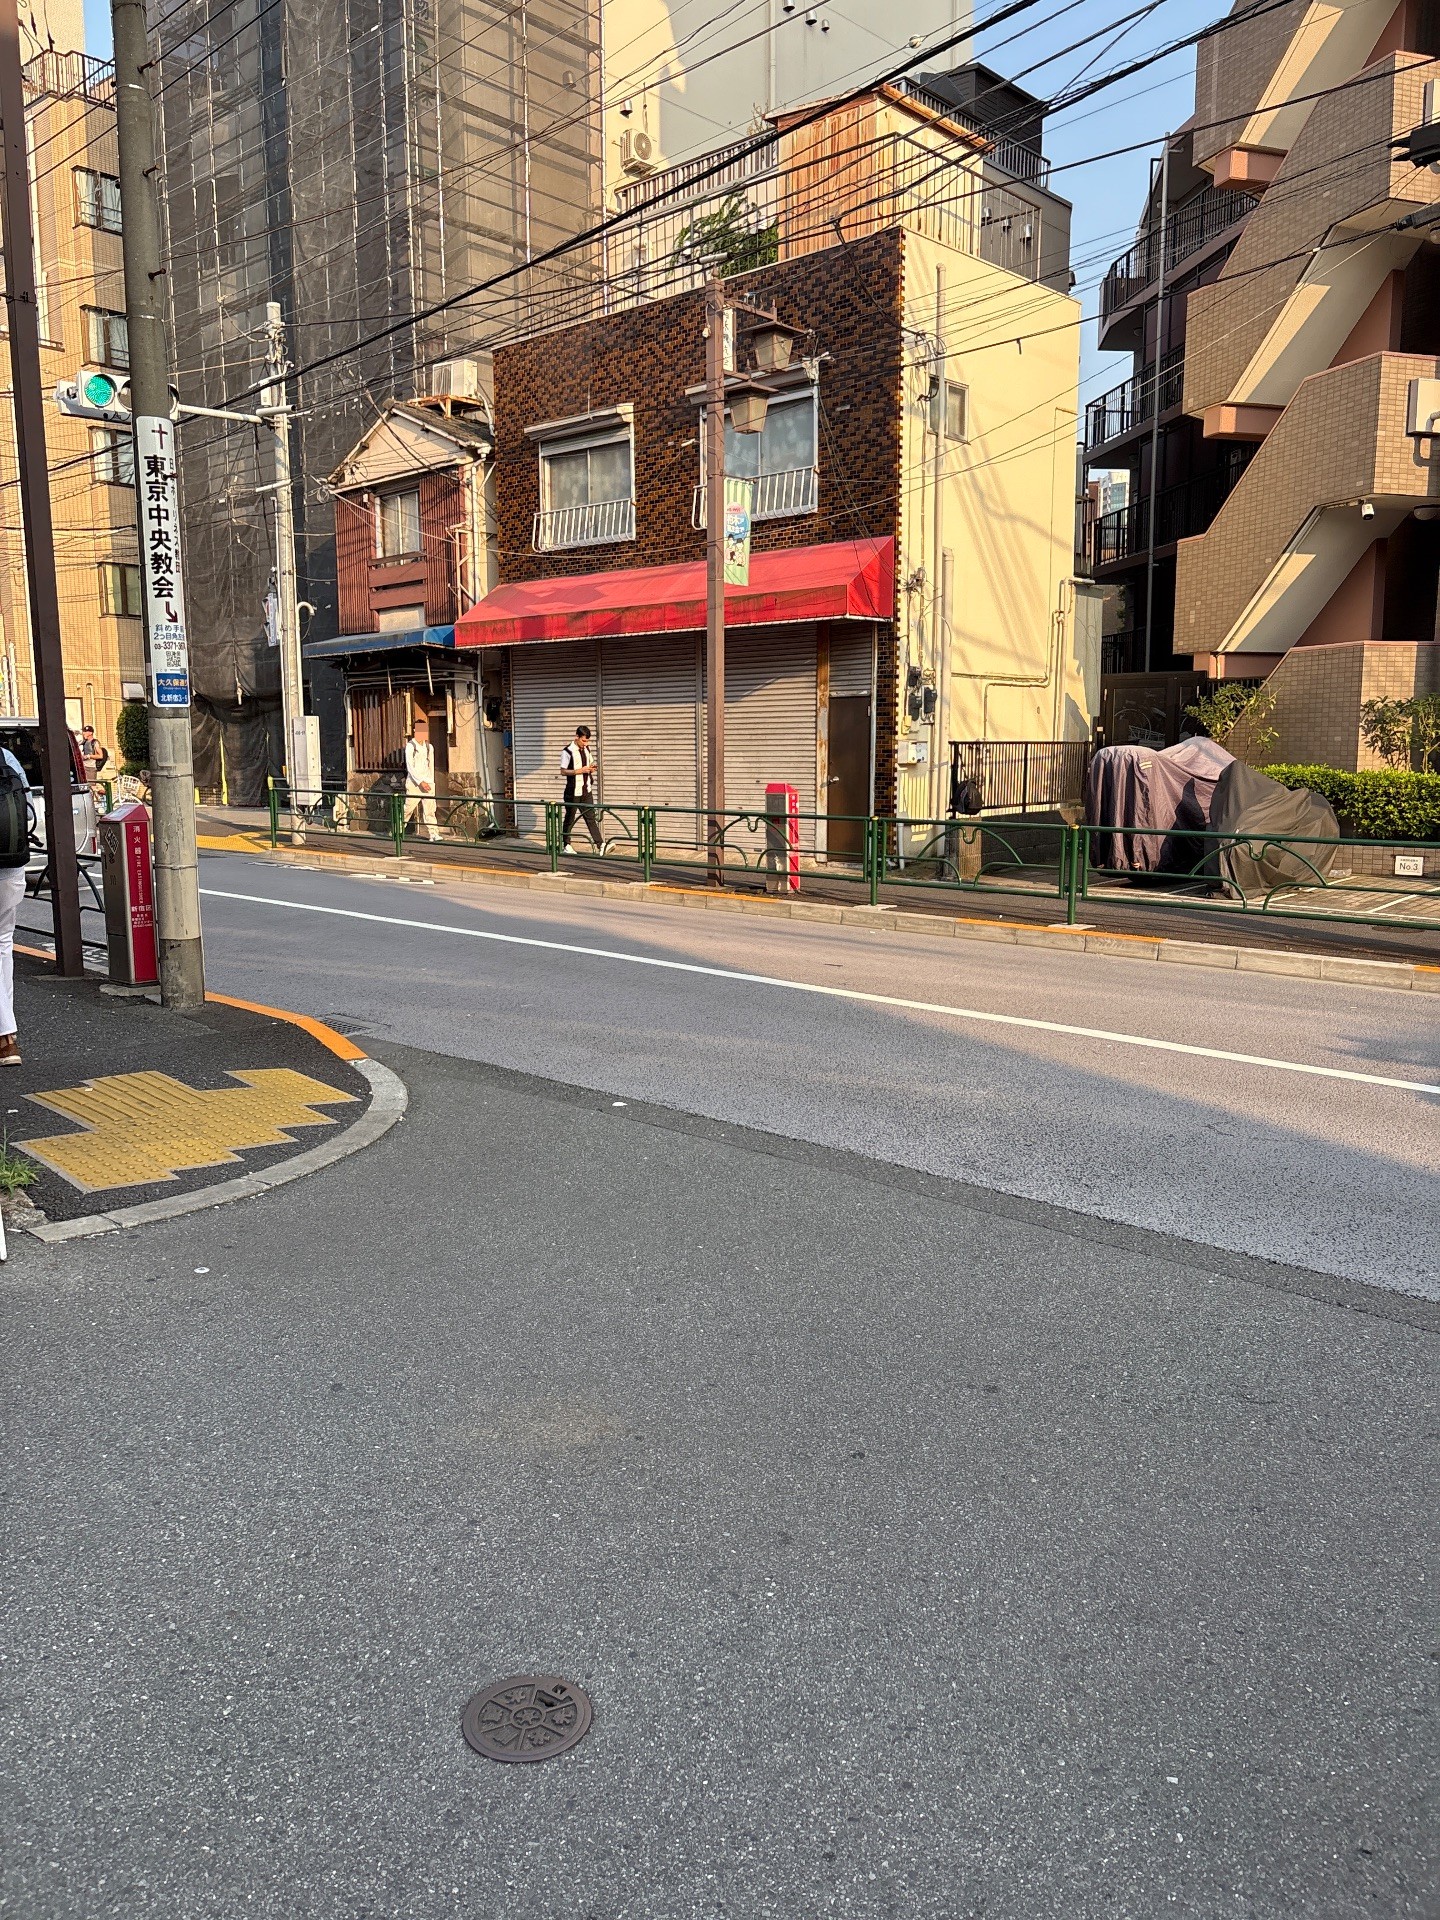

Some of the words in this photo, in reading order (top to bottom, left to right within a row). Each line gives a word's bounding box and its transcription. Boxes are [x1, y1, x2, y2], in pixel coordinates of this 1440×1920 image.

[143, 454, 174, 599] 東京中央教会
[1399, 862, 1418, 870] No.3
